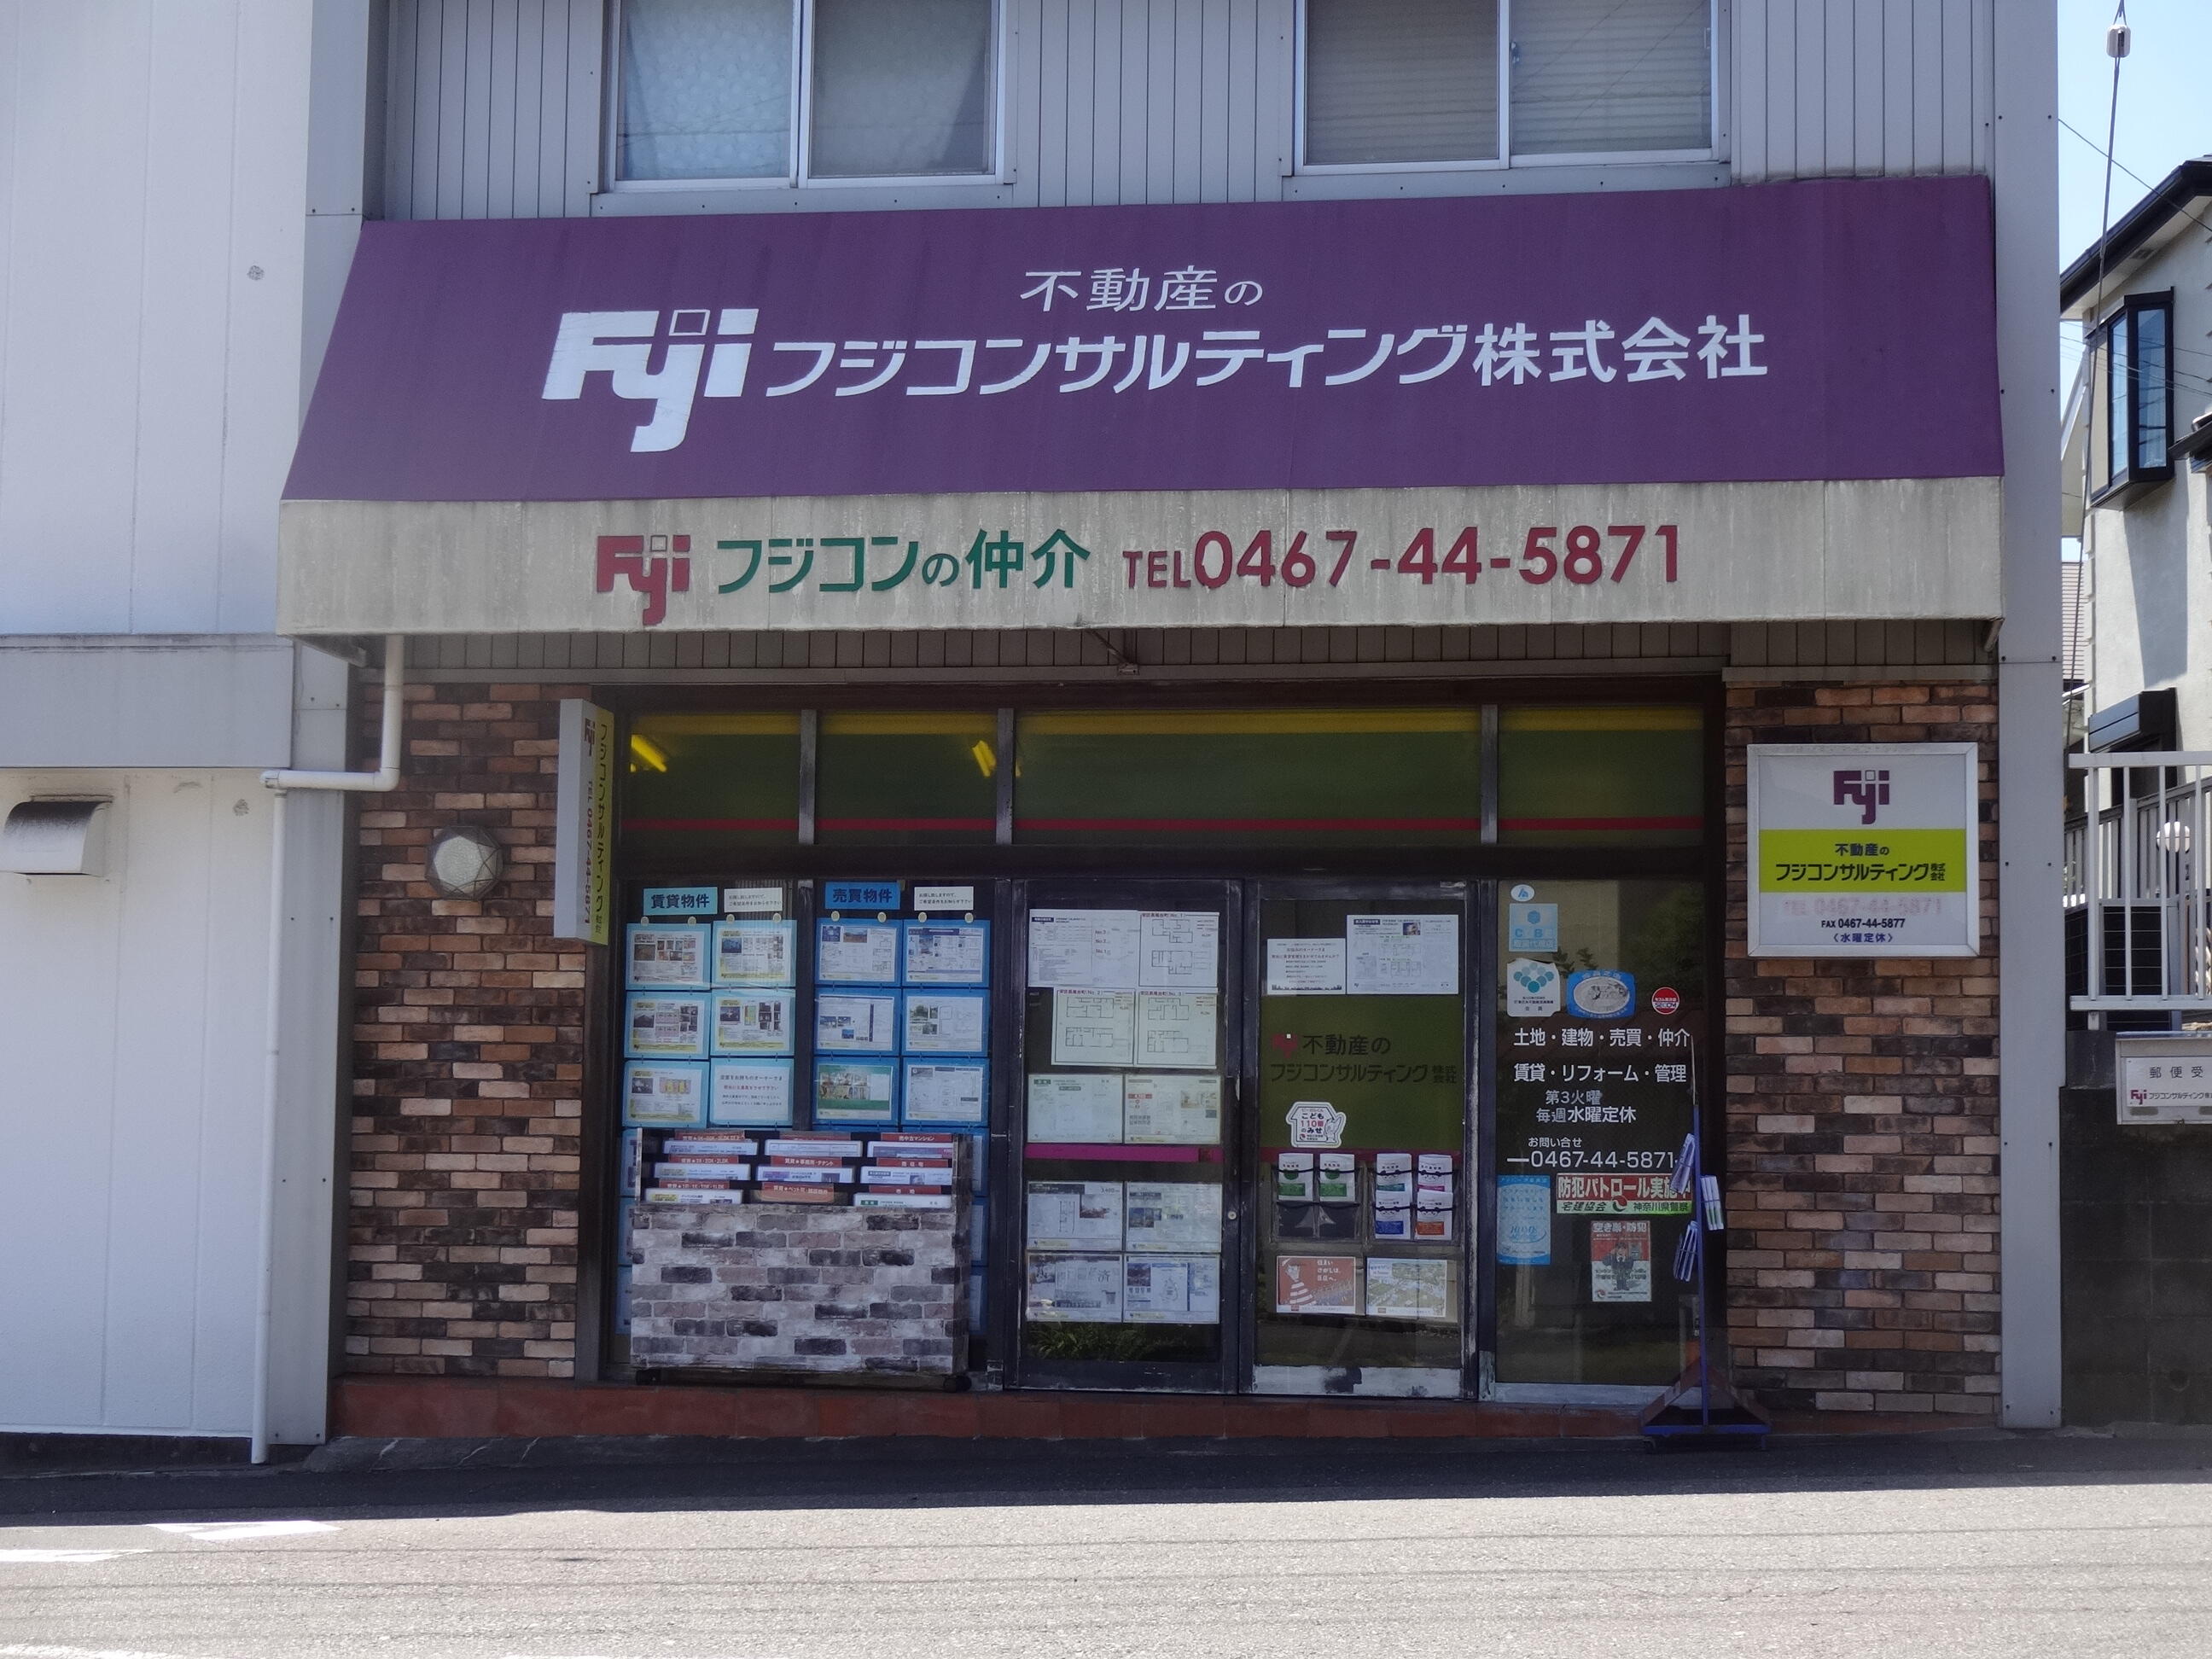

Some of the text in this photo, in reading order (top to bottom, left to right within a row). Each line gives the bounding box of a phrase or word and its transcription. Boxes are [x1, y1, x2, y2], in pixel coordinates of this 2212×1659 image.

[1020, 265, 1264, 312] 不動産の
[765, 313, 1769, 397] フジコンサルティング株式会社
[717, 528, 1091, 595] フジコンの仲介
[1122, 524, 1679, 590] TEL 0467-44-5871
[1835, 843, 1889, 857] 不動産の
[650, 893, 710, 909] 賃貸物件
[832, 888, 893, 903] 売買物件
[1821, 918, 1906, 928] FAX 0467-44-5877
[1302, 1034, 1391, 1055] 不動産の
[1513, 1027, 1691, 1047] 土地・建物・売買・仲介
[1513, 1062, 1687, 1082] 賃貸・リフォーム・管理
[2150, 1065, 2204, 1079] 郵便受
[1545, 1090, 1603, 1105] 第3火曜
[1536, 1105, 1637, 1124] 毎週水曜定休
[1528, 1137, 1583, 1149] お問い合せ
[1562, 1201, 1607, 1212] 宅建協会
[1633, 1201, 1689, 1212] 神奈川県警察
